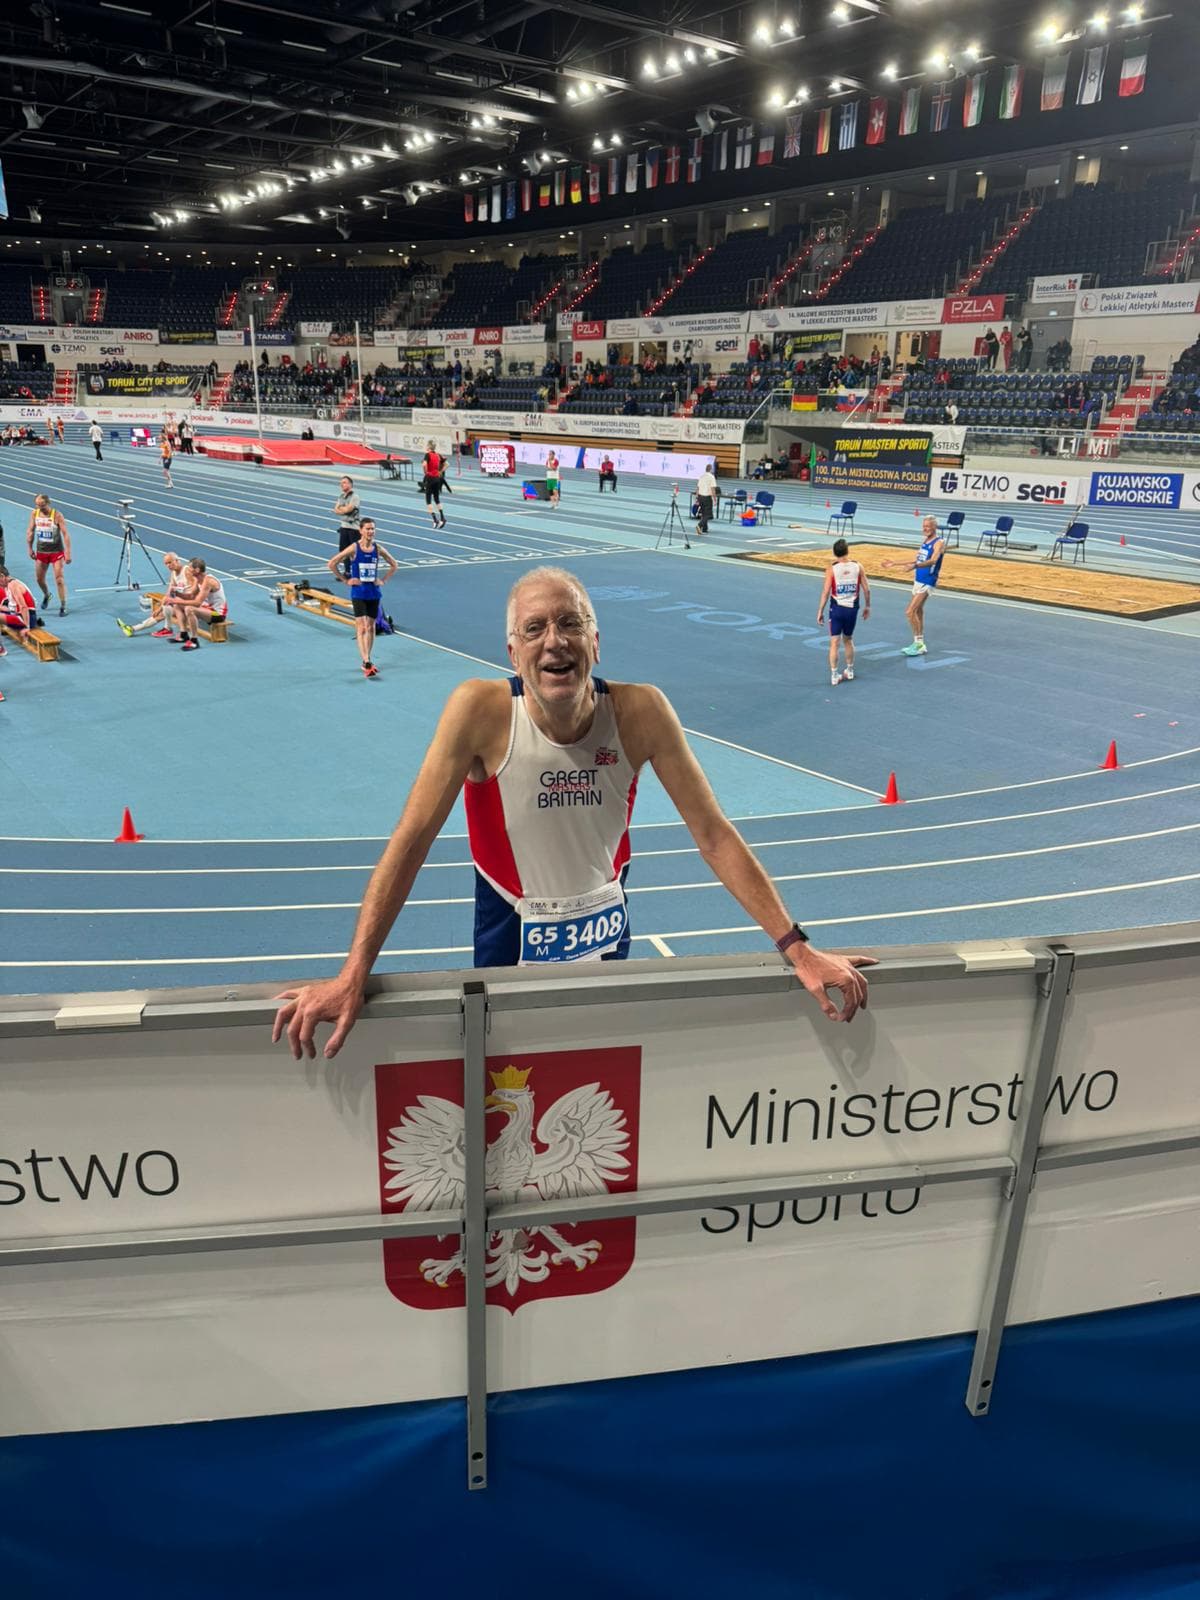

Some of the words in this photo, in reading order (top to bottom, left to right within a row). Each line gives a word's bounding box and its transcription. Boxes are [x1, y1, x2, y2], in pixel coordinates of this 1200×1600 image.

[1036, 283, 1067, 292] InterRisk
[1101, 292, 1125, 301] Polski
[1126, 290, 1158, 302] Związek
[856, 307, 878, 315] EUROPY
[951, 299, 995, 314] PZLA
[1100, 302, 1127, 312] Lekkiej
[1128, 300, 1160, 311] Atletyki
[1161, 299, 1194, 308] Masters
[123, 331, 153, 341] ANIRO
[479, 331, 499, 341] ANIRO
[576, 323, 600, 334] PZLA
[62, 344, 86, 352] TZMO
[100, 345, 125, 355] seni
[715, 336, 739, 351] seni
[137, 376, 154, 387] CITY
[155, 377, 163, 386] OF
[165, 375, 189, 385] SPORT
[835, 436, 861, 451] TORUŃ
[861, 438, 897, 451] MIASTEM
[898, 438, 929, 450] SPORTU
[1060, 437, 1076, 454] L1
[1089, 438, 1109, 455] M1
[816, 466, 829, 475] 100.
[831, 466, 848, 476] PZLA
[849, 468, 900, 480] MISTRZOSTWA
[901, 471, 929, 482] POLSKI
[962, 473, 1010, 492] TZMO
[1097, 474, 1172, 490] KUJAWSKO
[1016, 480, 1068, 503] seni
[1096, 489, 1175, 505] POMORSKIE
[540, 769, 598, 787] GREAT
[548, 782, 592, 792] MASTERS
[538, 789, 602, 808] BRITAIN
[527, 926, 558, 945] 65
[563, 911, 623, 951] 3408
[536, 945, 549, 957] M
[706, 1069, 1119, 1149] Ministerstwo
[0, 1148, 180, 1206] stwo
